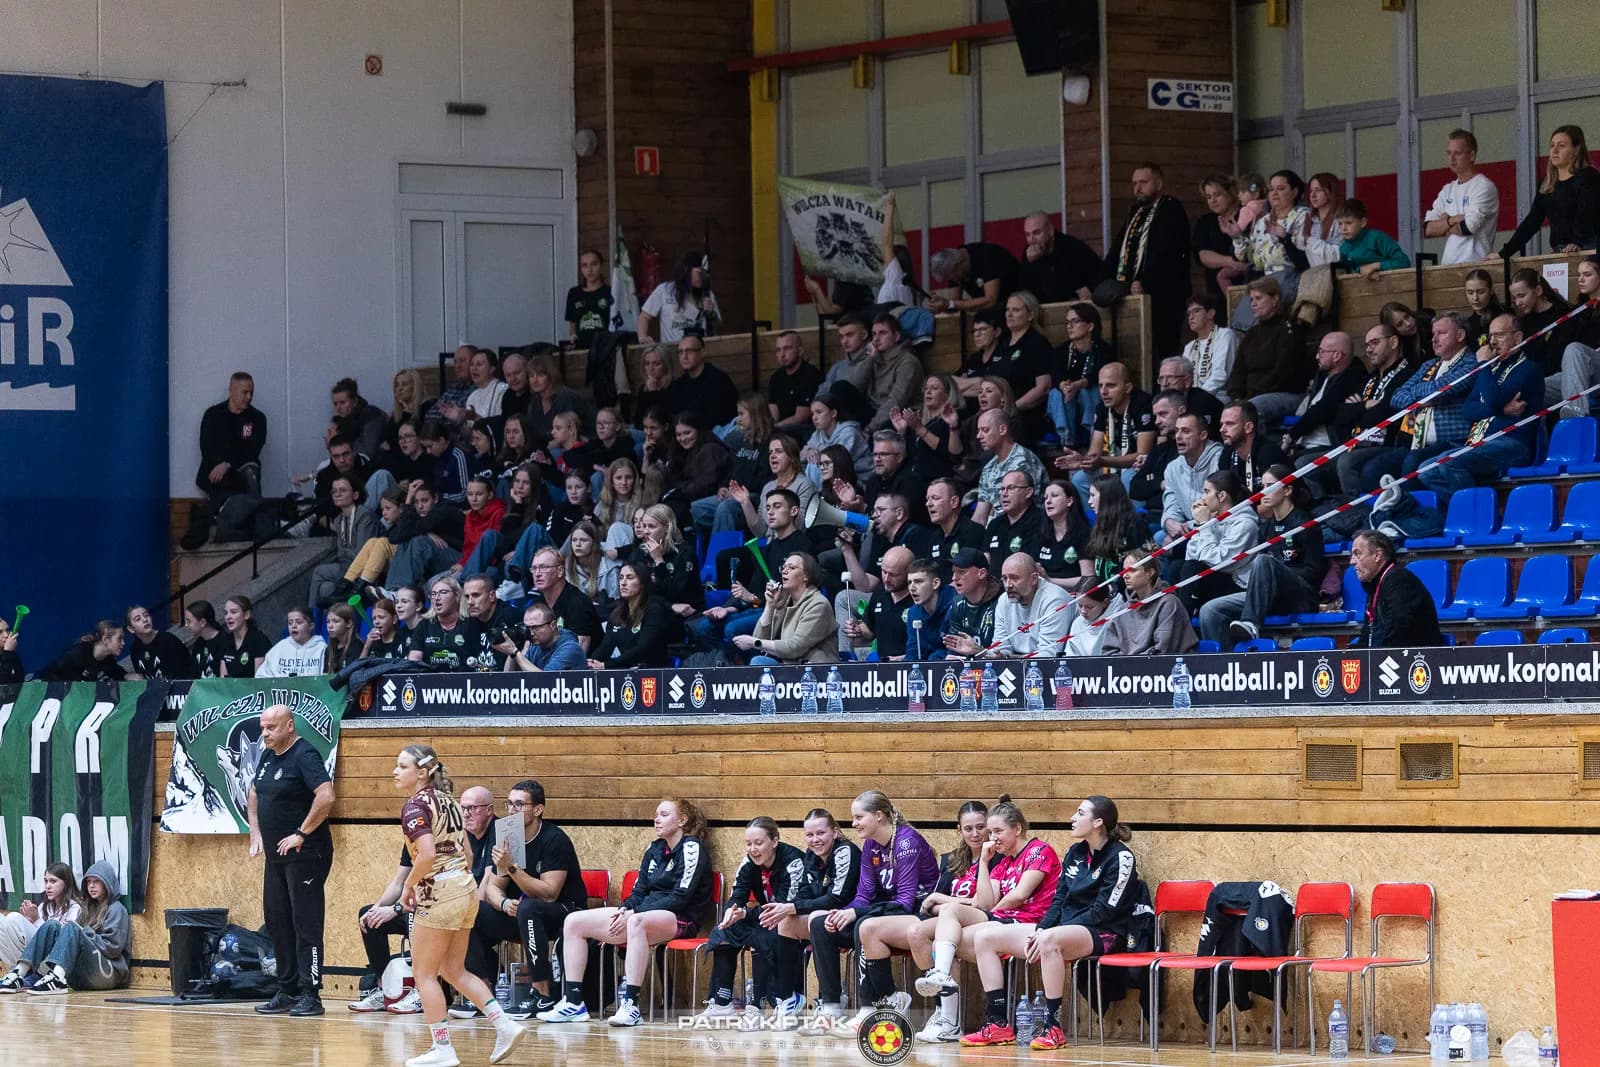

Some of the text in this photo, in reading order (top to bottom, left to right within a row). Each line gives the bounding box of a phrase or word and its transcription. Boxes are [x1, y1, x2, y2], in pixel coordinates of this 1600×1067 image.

[1151, 81, 1172, 106] C
[1176, 82, 1231, 93] SEKTOR
[1176, 92, 1201, 109] G
[792, 195, 831, 215] WILCZA
[1343, 673, 1358, 690] CK
[422, 678, 615, 712] www.koronahandball.pl
[642, 689, 653, 704] CK
[182, 689, 335, 744] WILCZA WATAHA
[0, 698, 115, 773] PR
[442, 803, 463, 833] 20
[951, 879, 972, 898] 18
